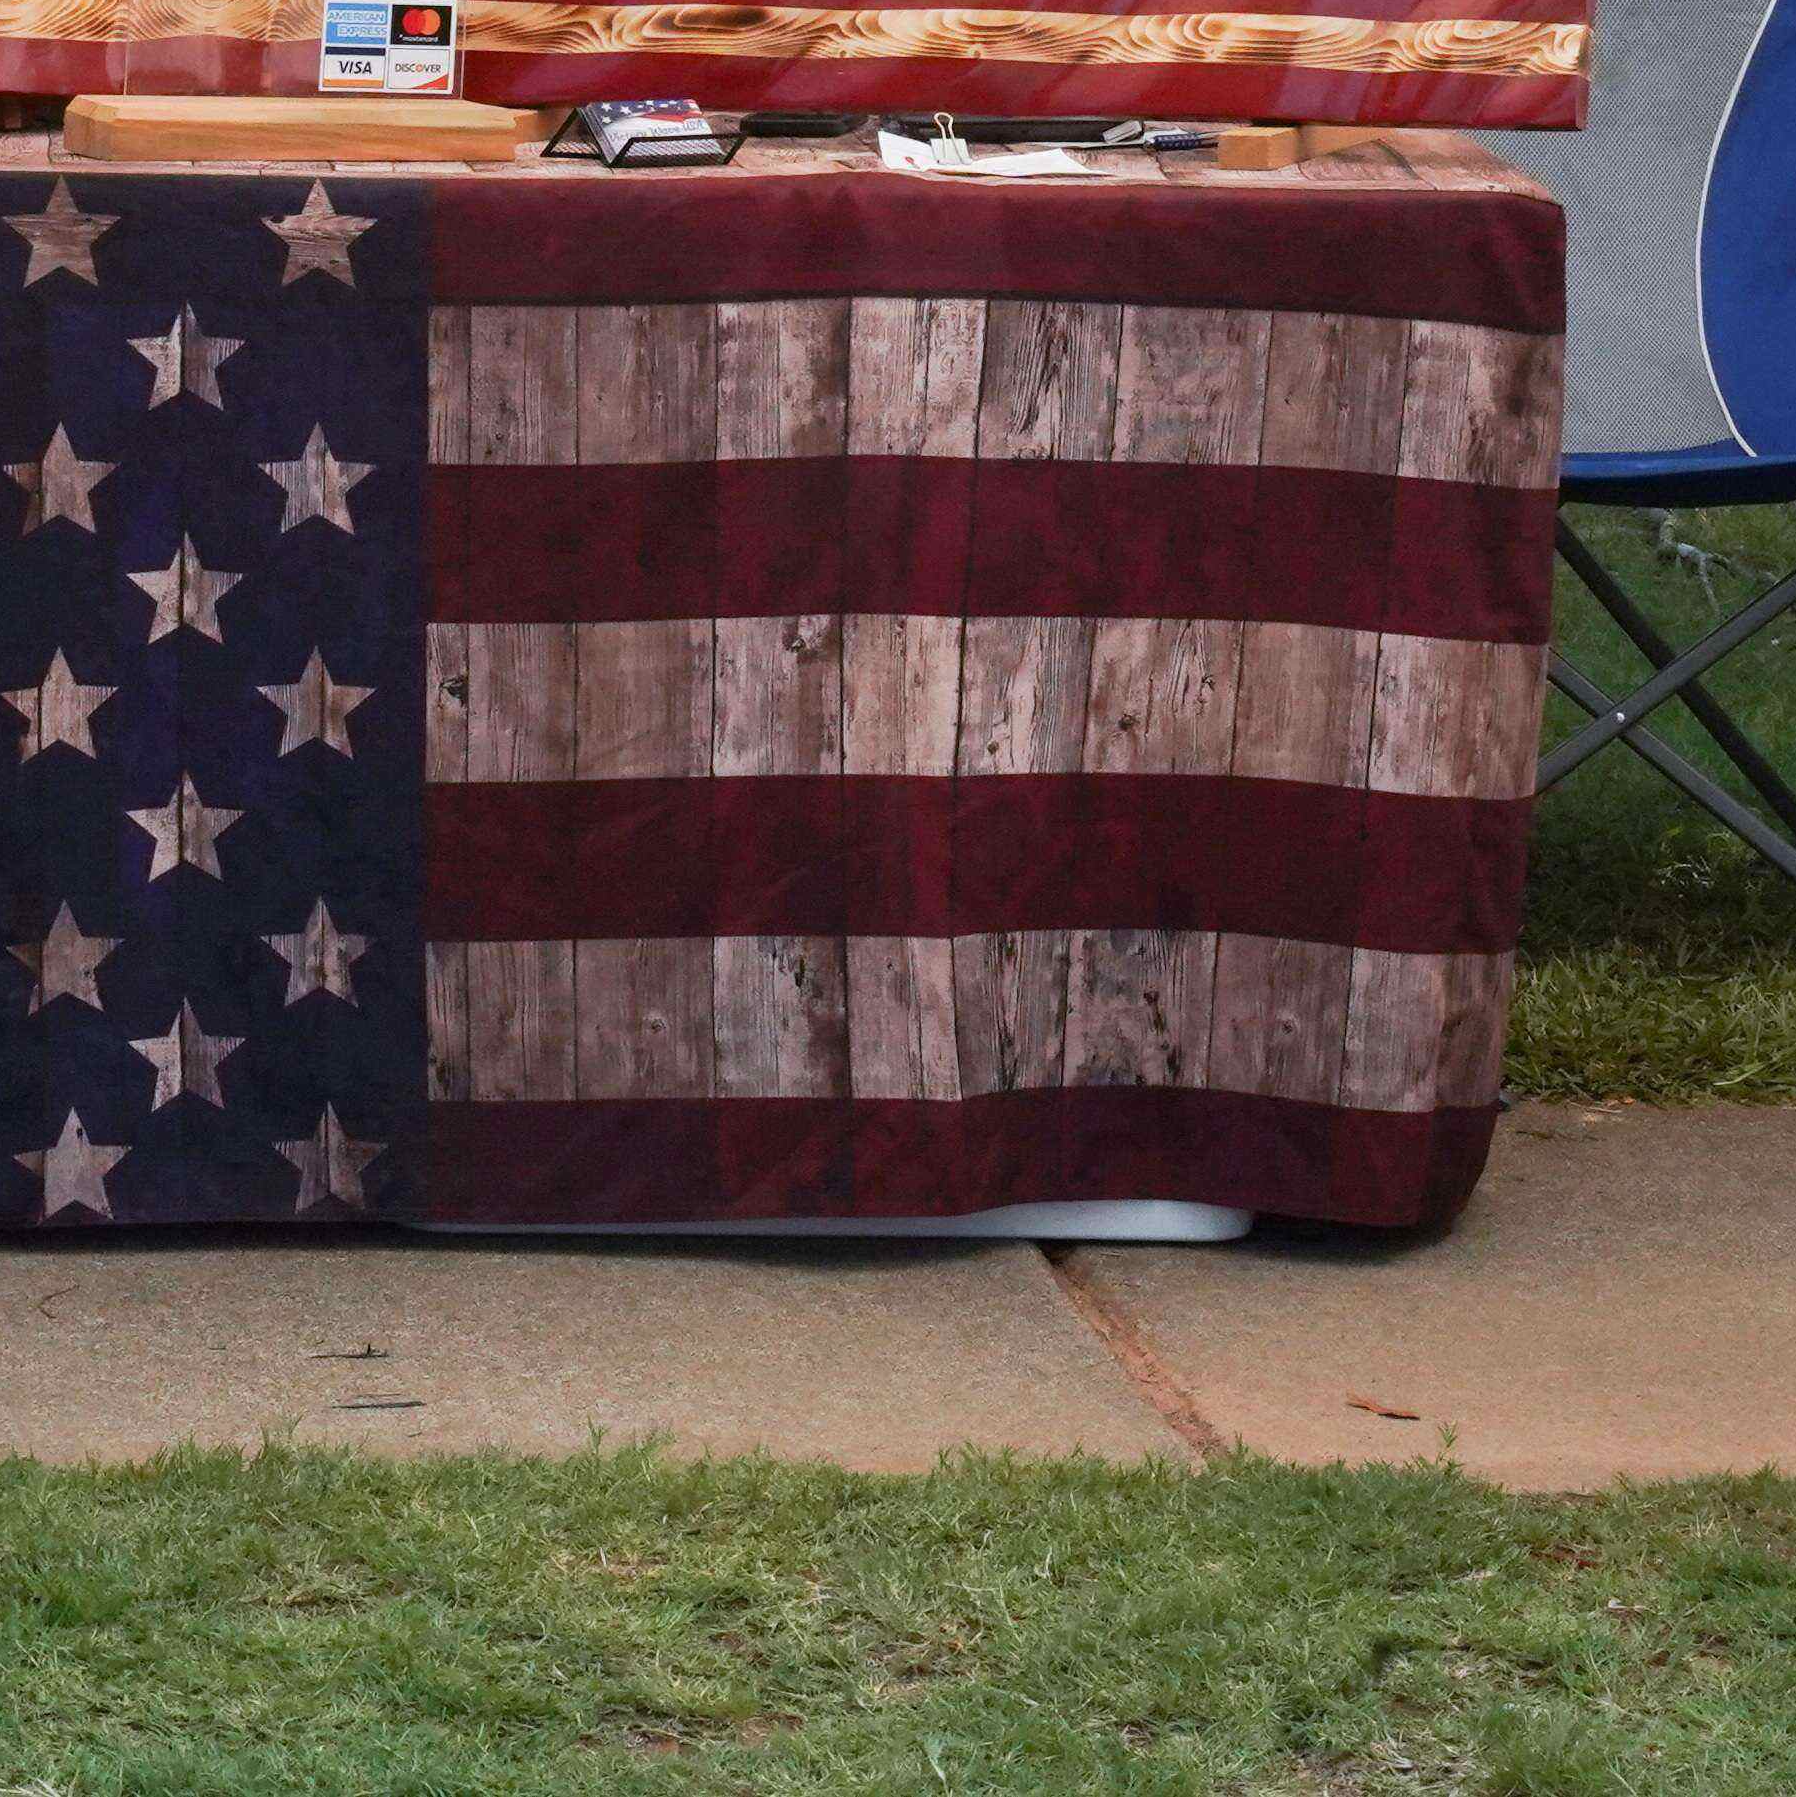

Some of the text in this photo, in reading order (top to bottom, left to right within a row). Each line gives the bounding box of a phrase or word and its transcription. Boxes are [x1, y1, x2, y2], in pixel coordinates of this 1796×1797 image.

[327, 10, 386, 23] AMERICAN
[337, 25, 387, 36] EXPRESS
[339, 61, 372, 74] VISA
[395, 63, 441, 73] DISCOVER
